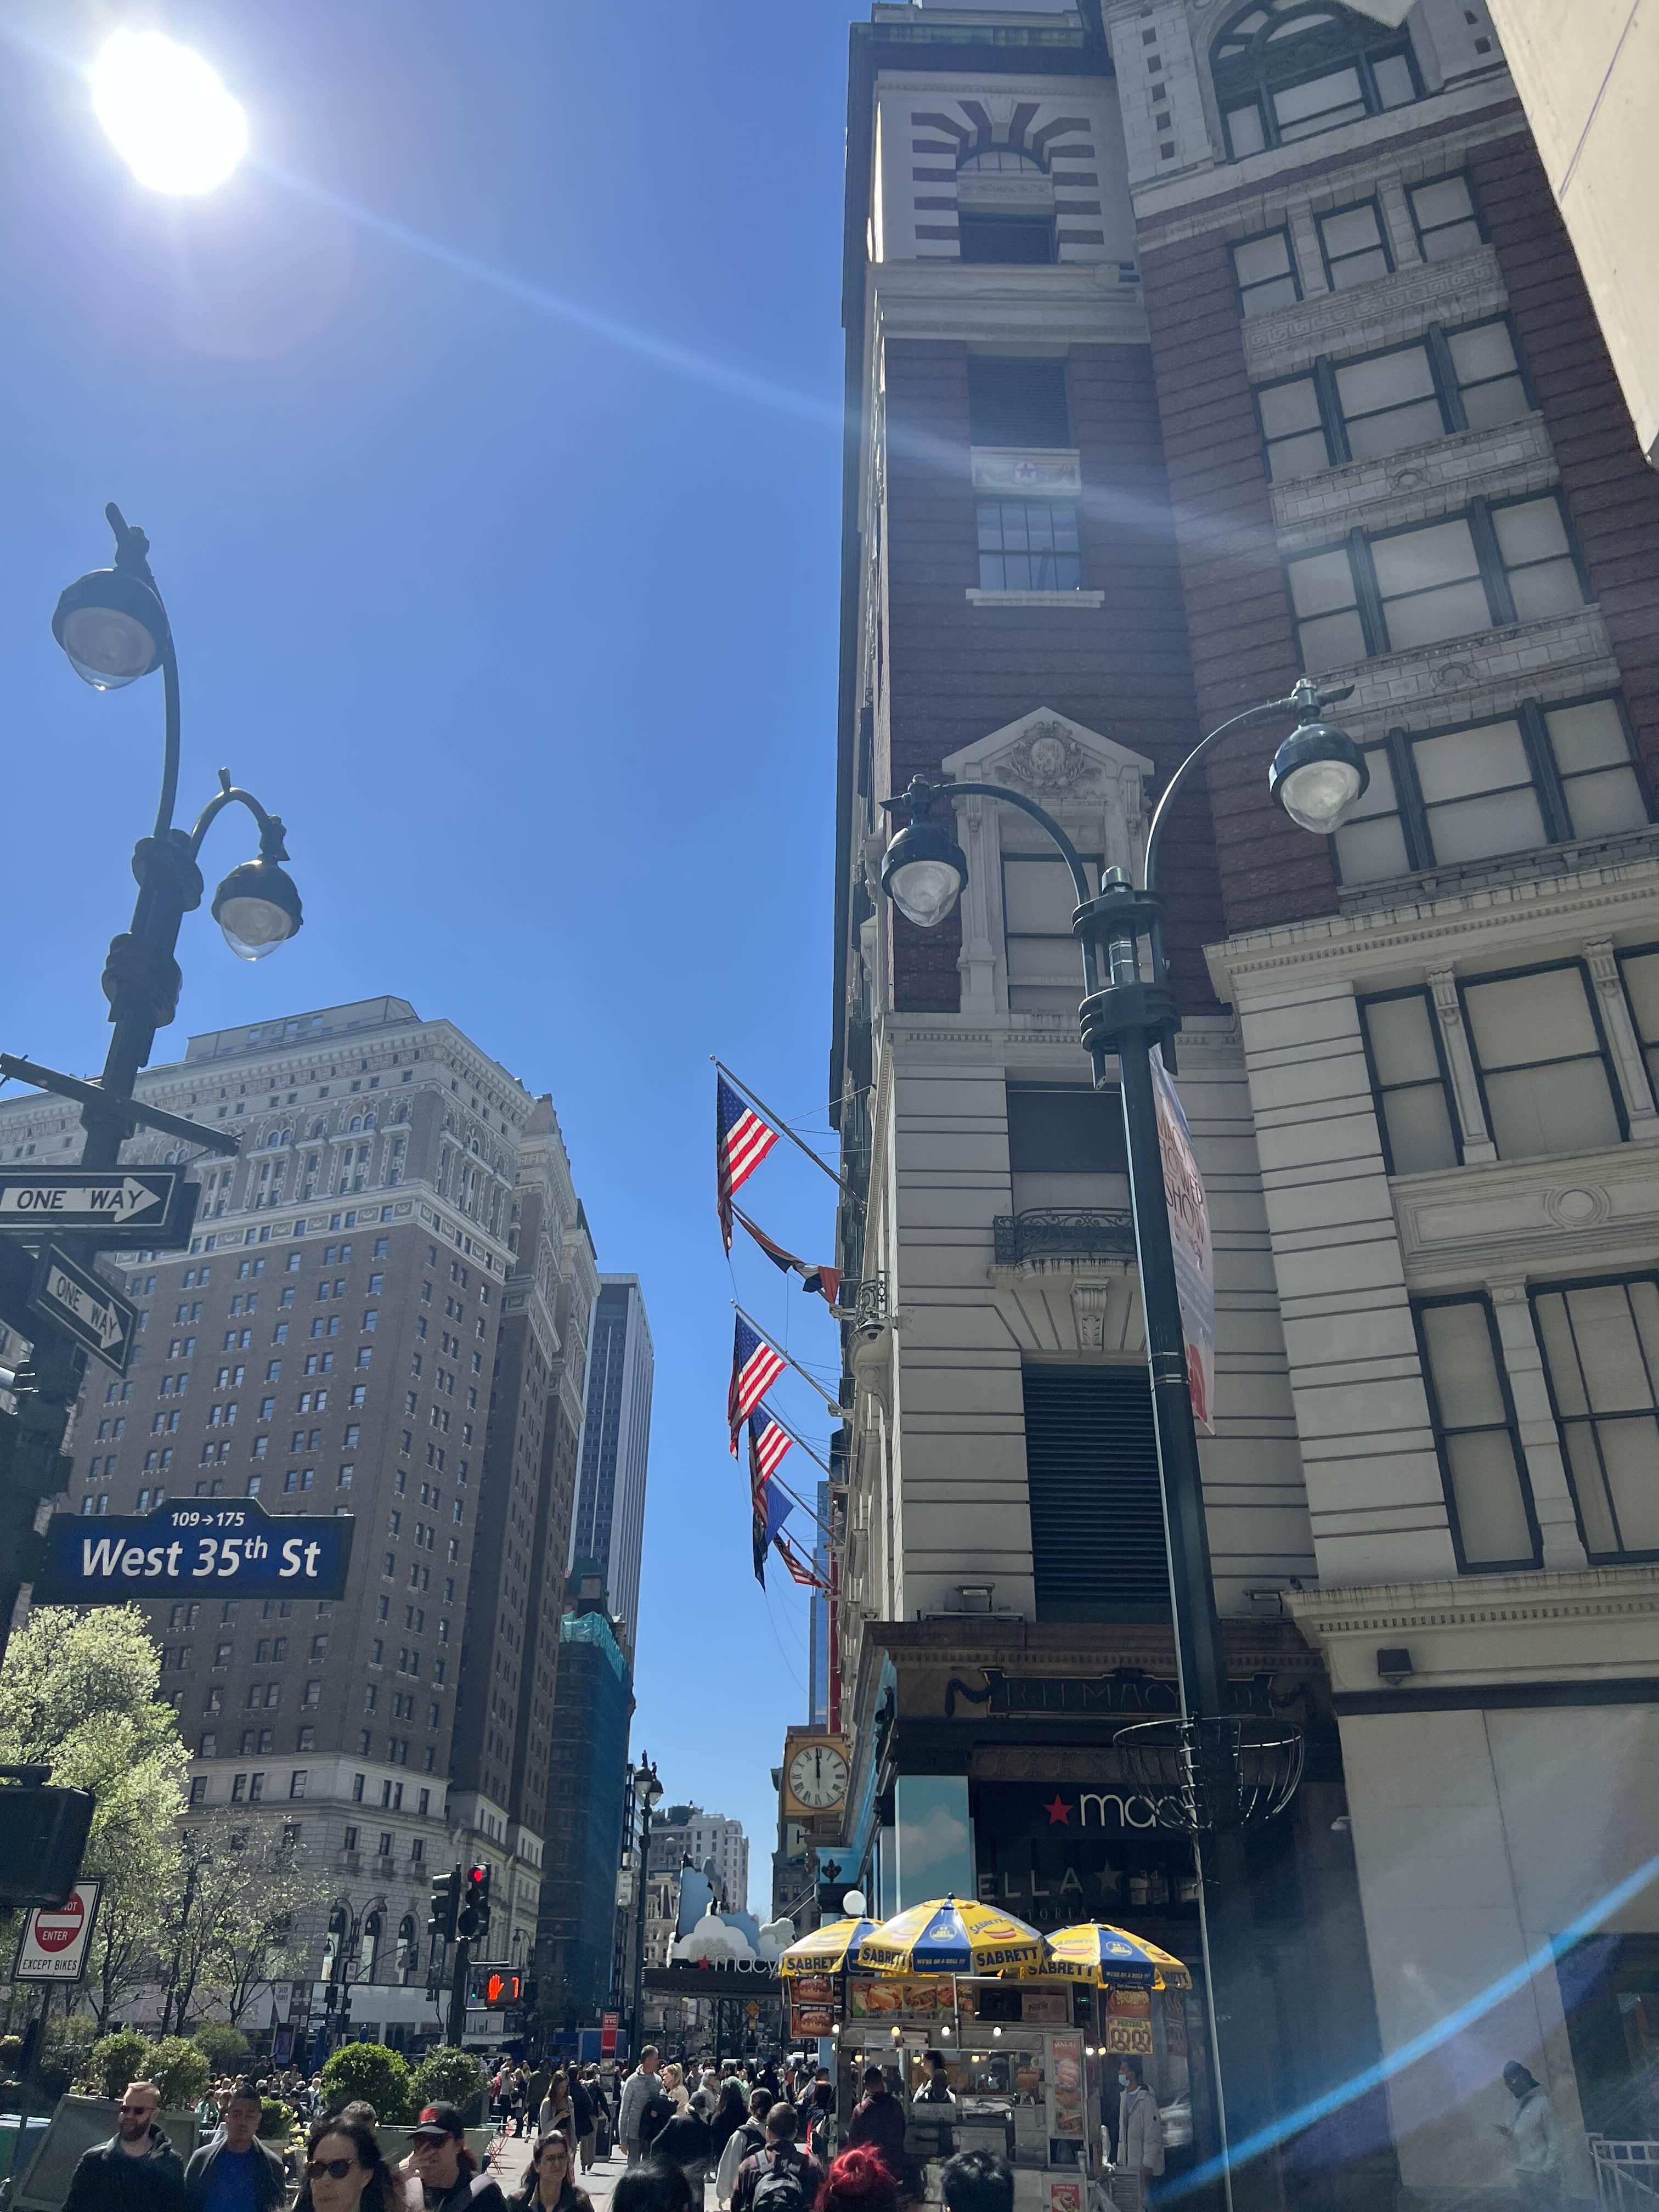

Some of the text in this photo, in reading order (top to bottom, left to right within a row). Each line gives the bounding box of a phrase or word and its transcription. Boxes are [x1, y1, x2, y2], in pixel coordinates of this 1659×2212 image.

[17, 1190, 145, 1209] ONE WAY
[1164, 1172, 1204, 1244] SHOW
[57, 1276, 118, 1340] ONE WAY
[172, 1512, 245, 1527] 109 175
[83, 1536, 321, 1577] West 35th St
[1080, 1793, 1187, 1828] mac
[978, 1867, 1084, 1901] ELLA
[1014, 1906, 1088, 1920] TTORIA
[42, 1931, 68, 1940] ENTER
[22, 1959, 77, 1971] EXCEPT BIKES
[787, 1956, 841, 1970] SABRET
[977, 1946, 1038, 1967] SABRETT
[714, 1955, 778, 1979] macy
[1028, 1961, 1093, 1977] SABRETT
